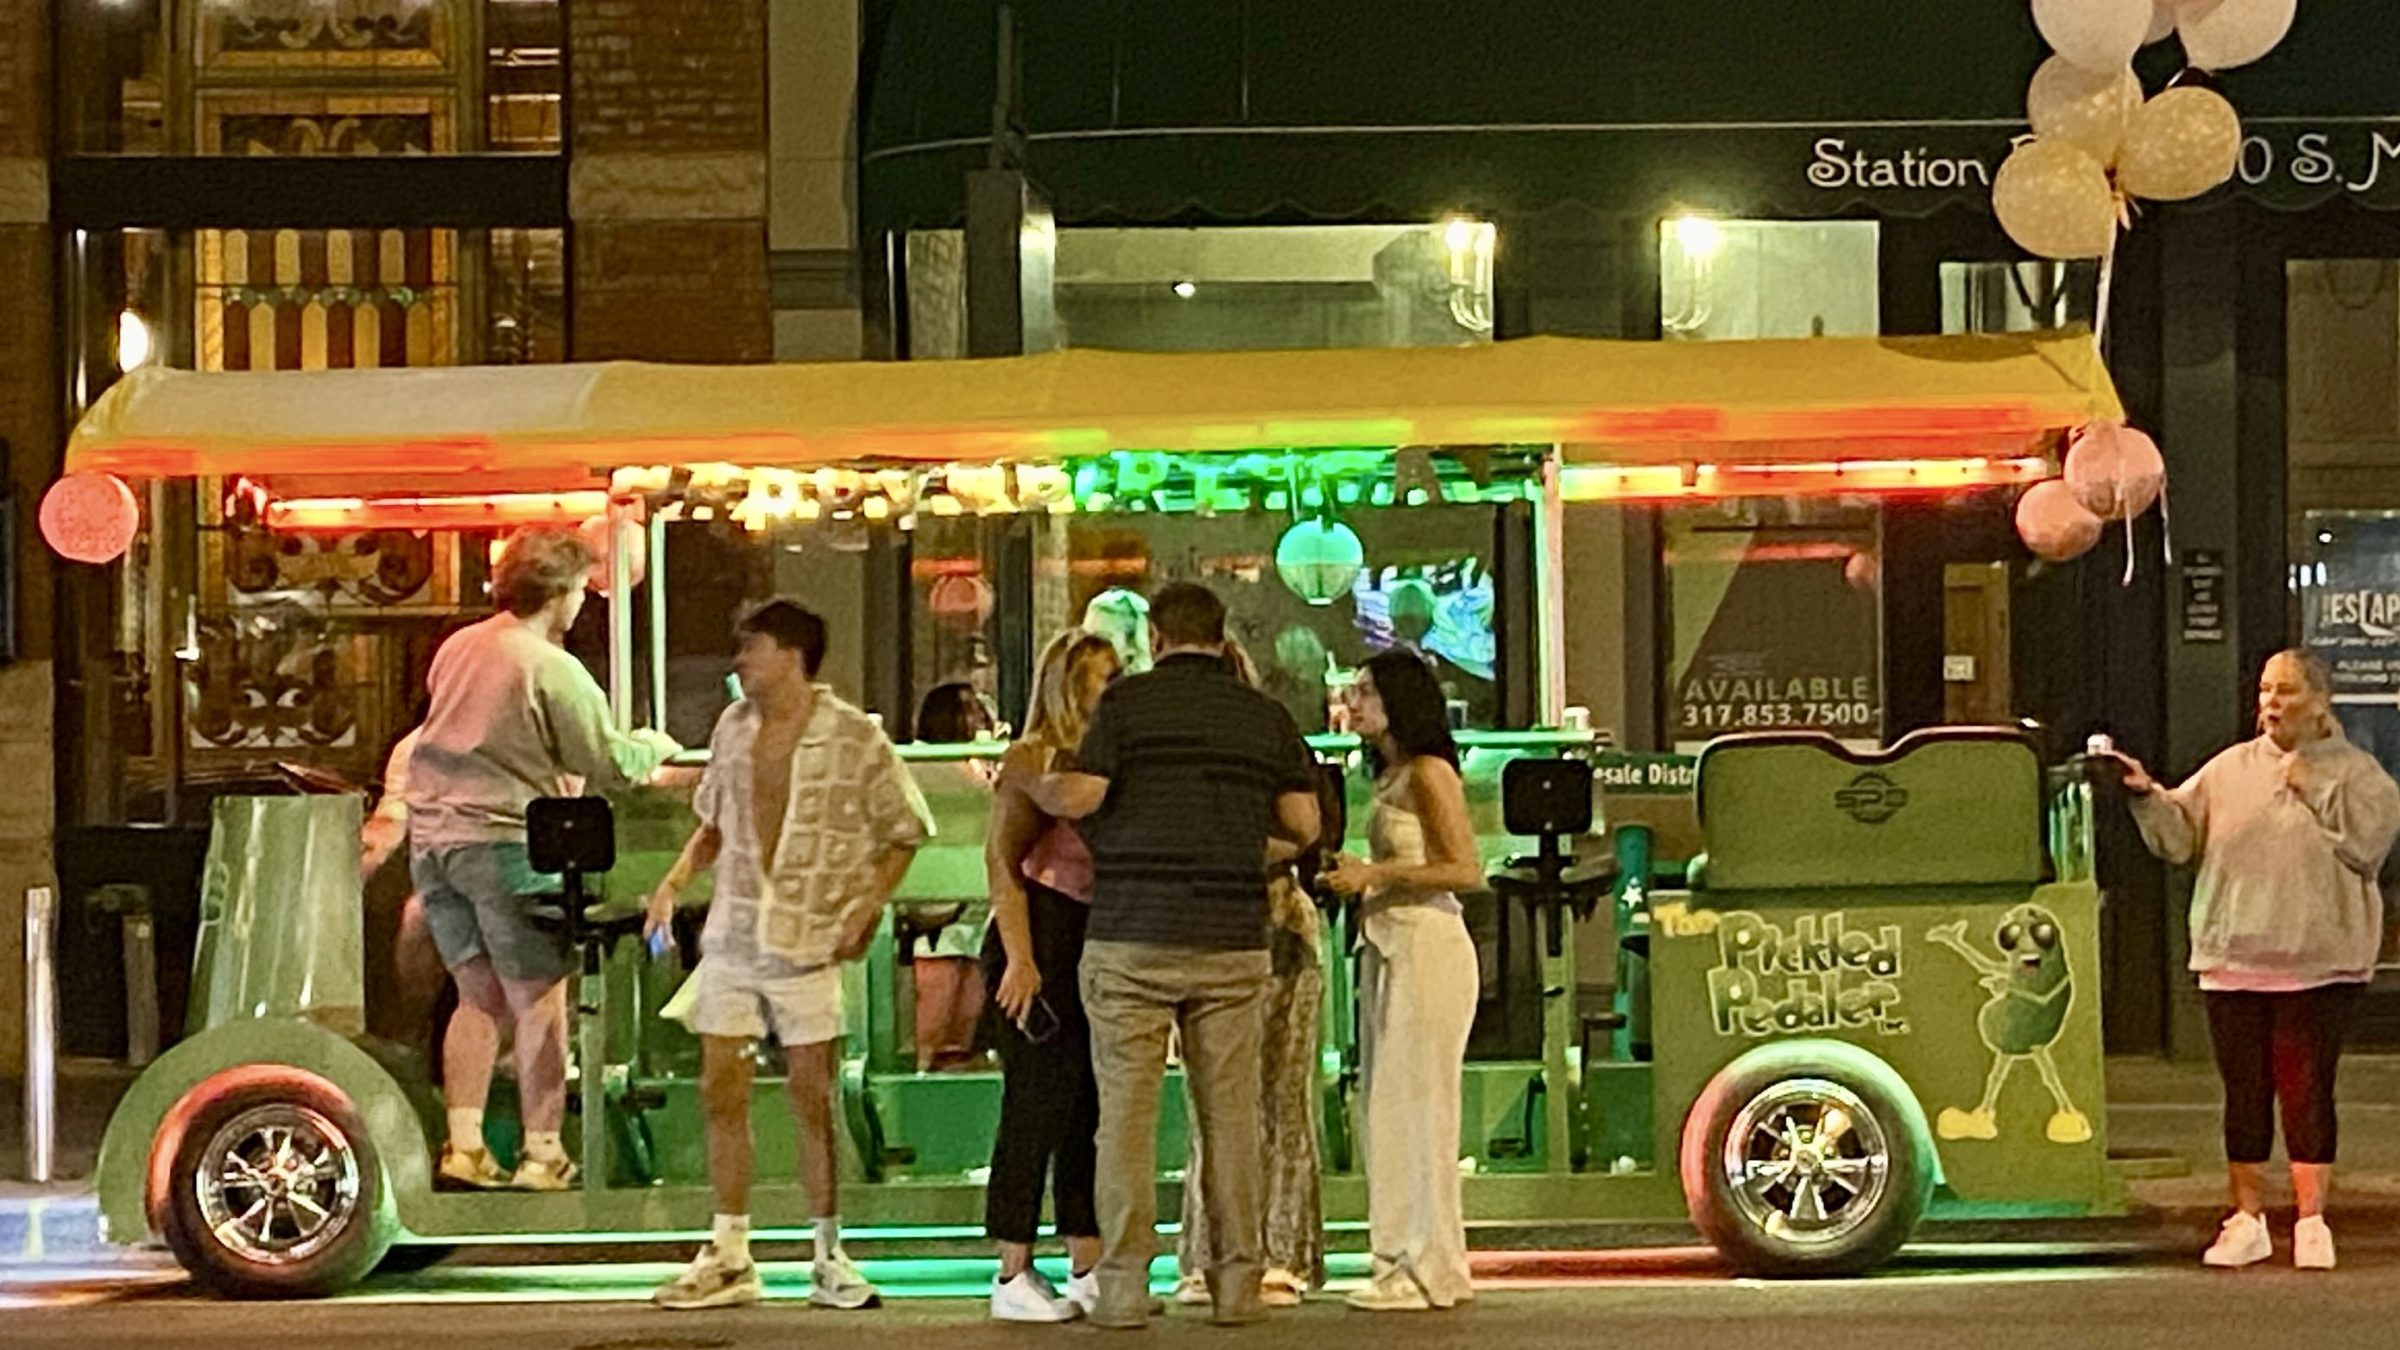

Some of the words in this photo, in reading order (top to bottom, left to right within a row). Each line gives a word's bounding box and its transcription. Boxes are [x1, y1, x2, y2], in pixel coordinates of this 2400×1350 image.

[1806, 138, 1989, 188] Station
[2290, 133, 2343, 184] S.
[1684, 676, 1870, 701] AVAILABLE
[1683, 702, 1869, 727] 317.853.7500
[1718, 910, 1901, 980] Pickled
